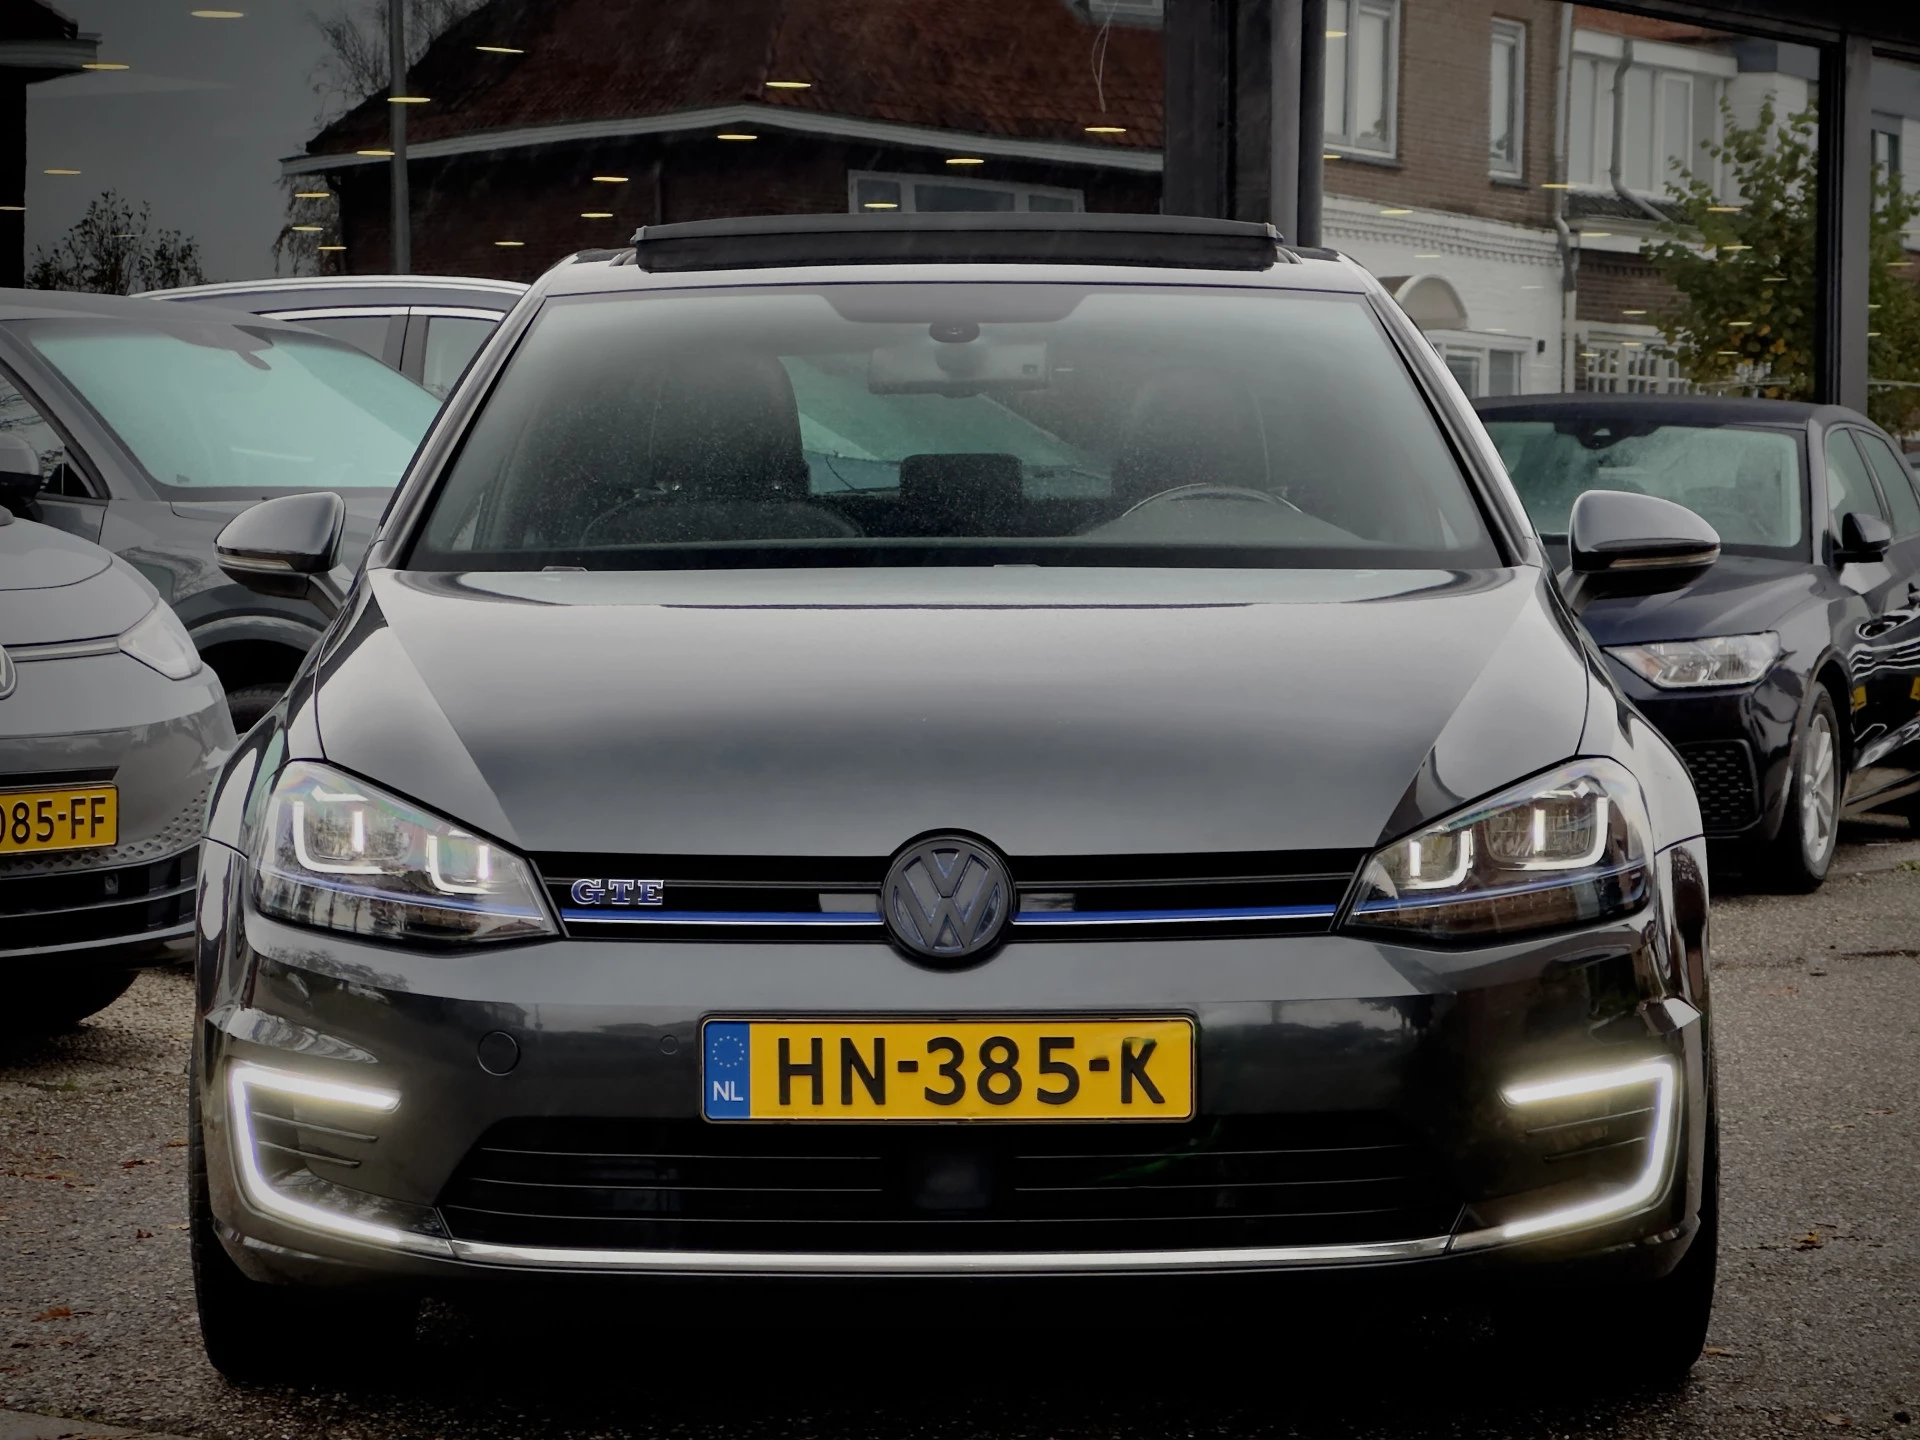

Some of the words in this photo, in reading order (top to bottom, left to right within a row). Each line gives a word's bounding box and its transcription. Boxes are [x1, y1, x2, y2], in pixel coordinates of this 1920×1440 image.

[571, 879, 664, 905] GTE
[778, 1036, 1166, 1106] HN-385-K
[713, 1081, 744, 1102] NL
